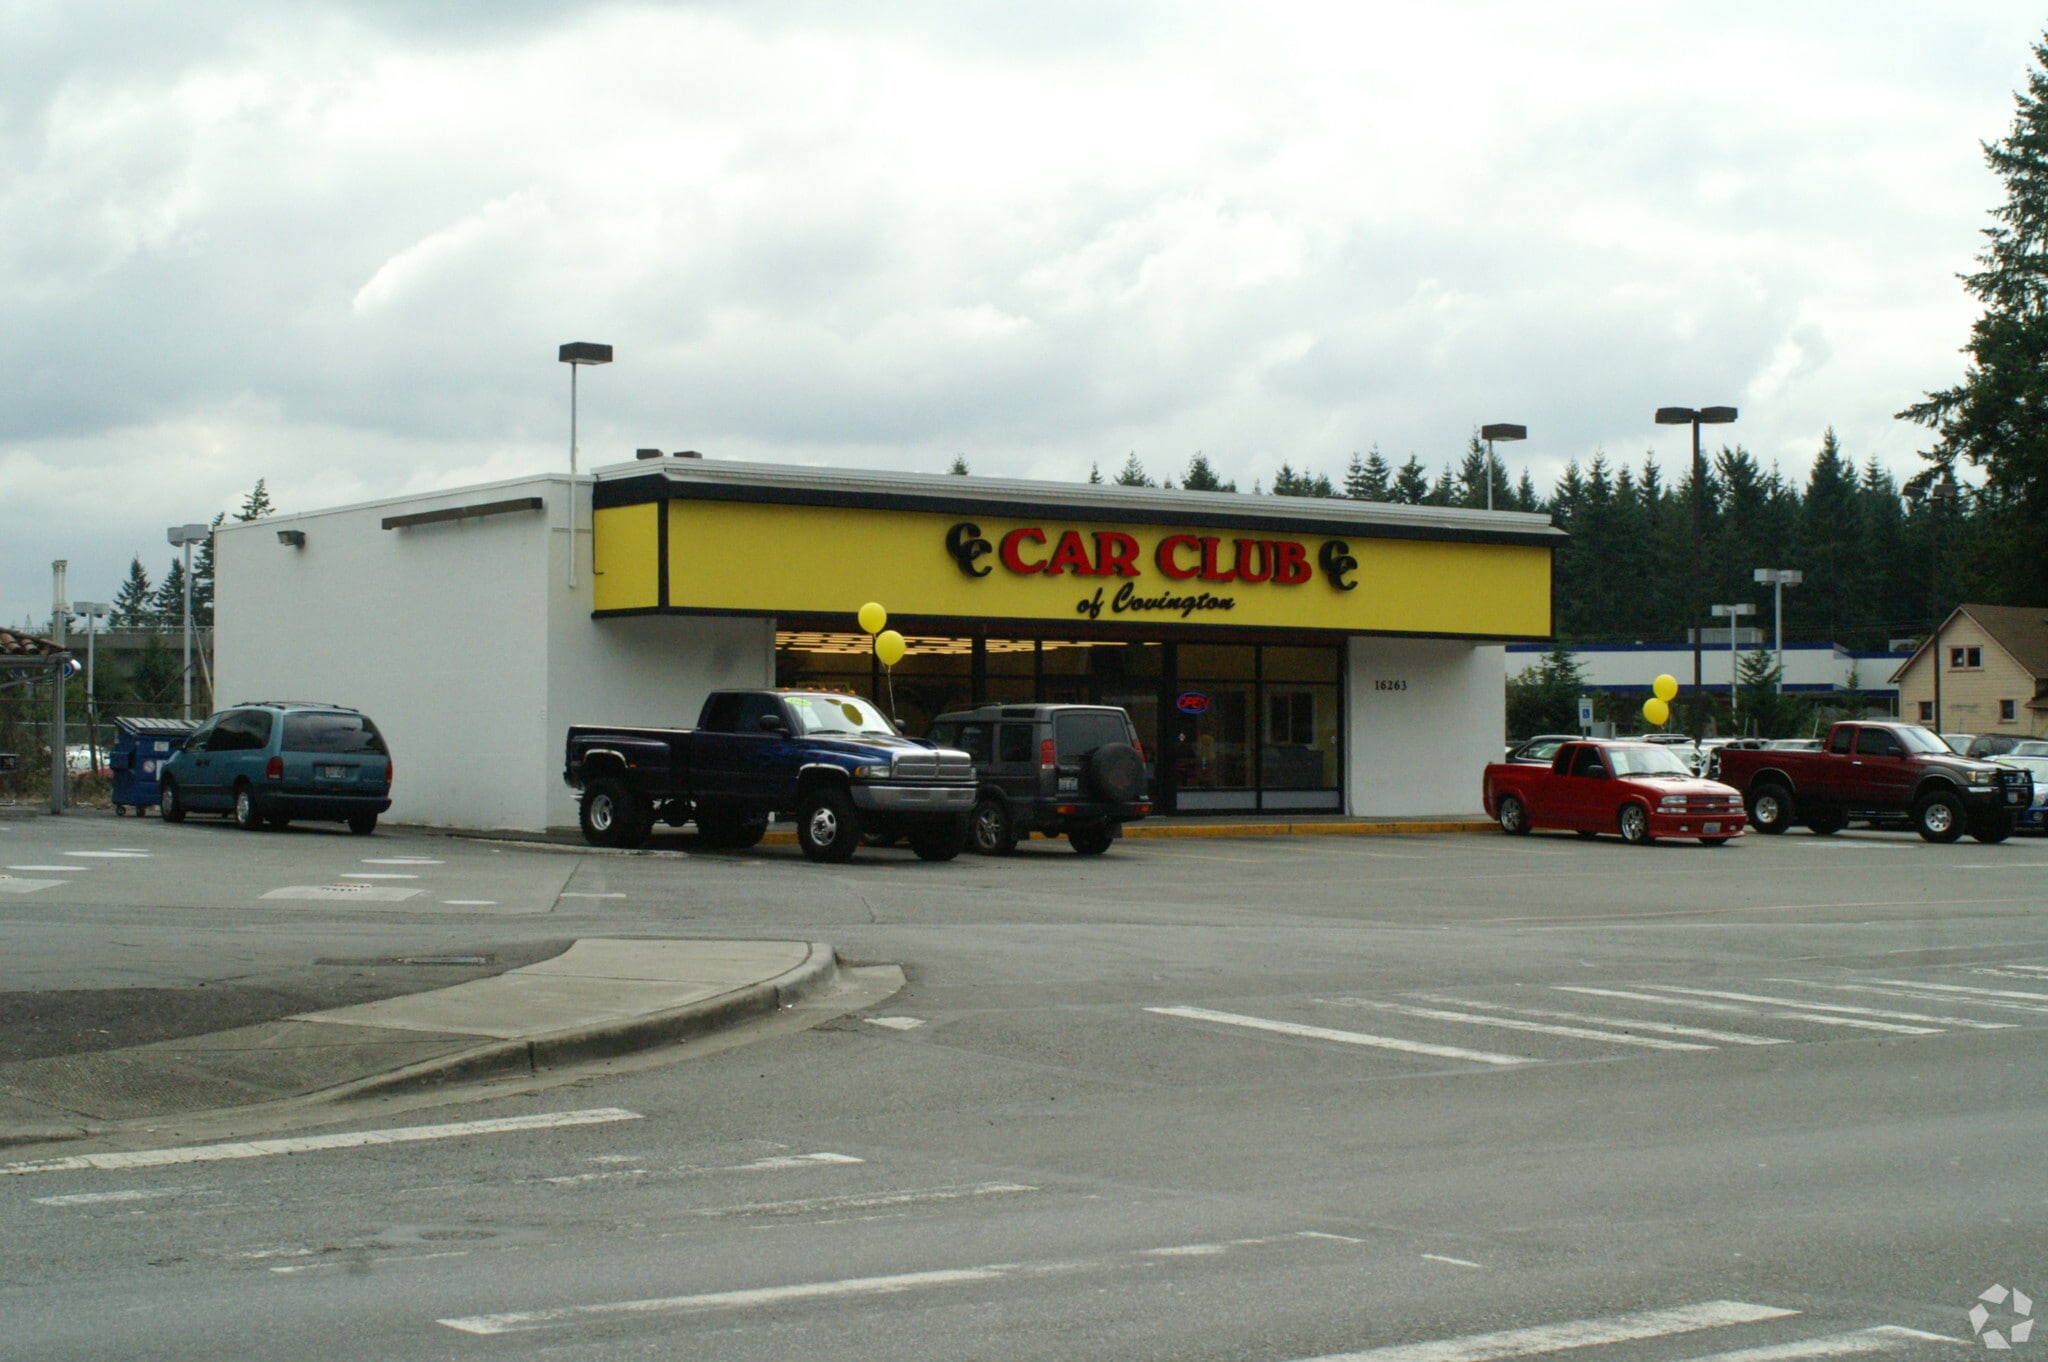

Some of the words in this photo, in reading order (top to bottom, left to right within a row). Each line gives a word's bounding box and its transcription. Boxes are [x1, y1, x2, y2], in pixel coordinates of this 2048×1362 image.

[1000, 527, 1141, 577] CAR
[1155, 535, 1312, 585] CLUB
[1076, 588, 1104, 620] of
[1112, 582, 1236, 618] Covington
[1374, 679, 1408, 691] 16263
[1177, 694, 1209, 710] OPEN
